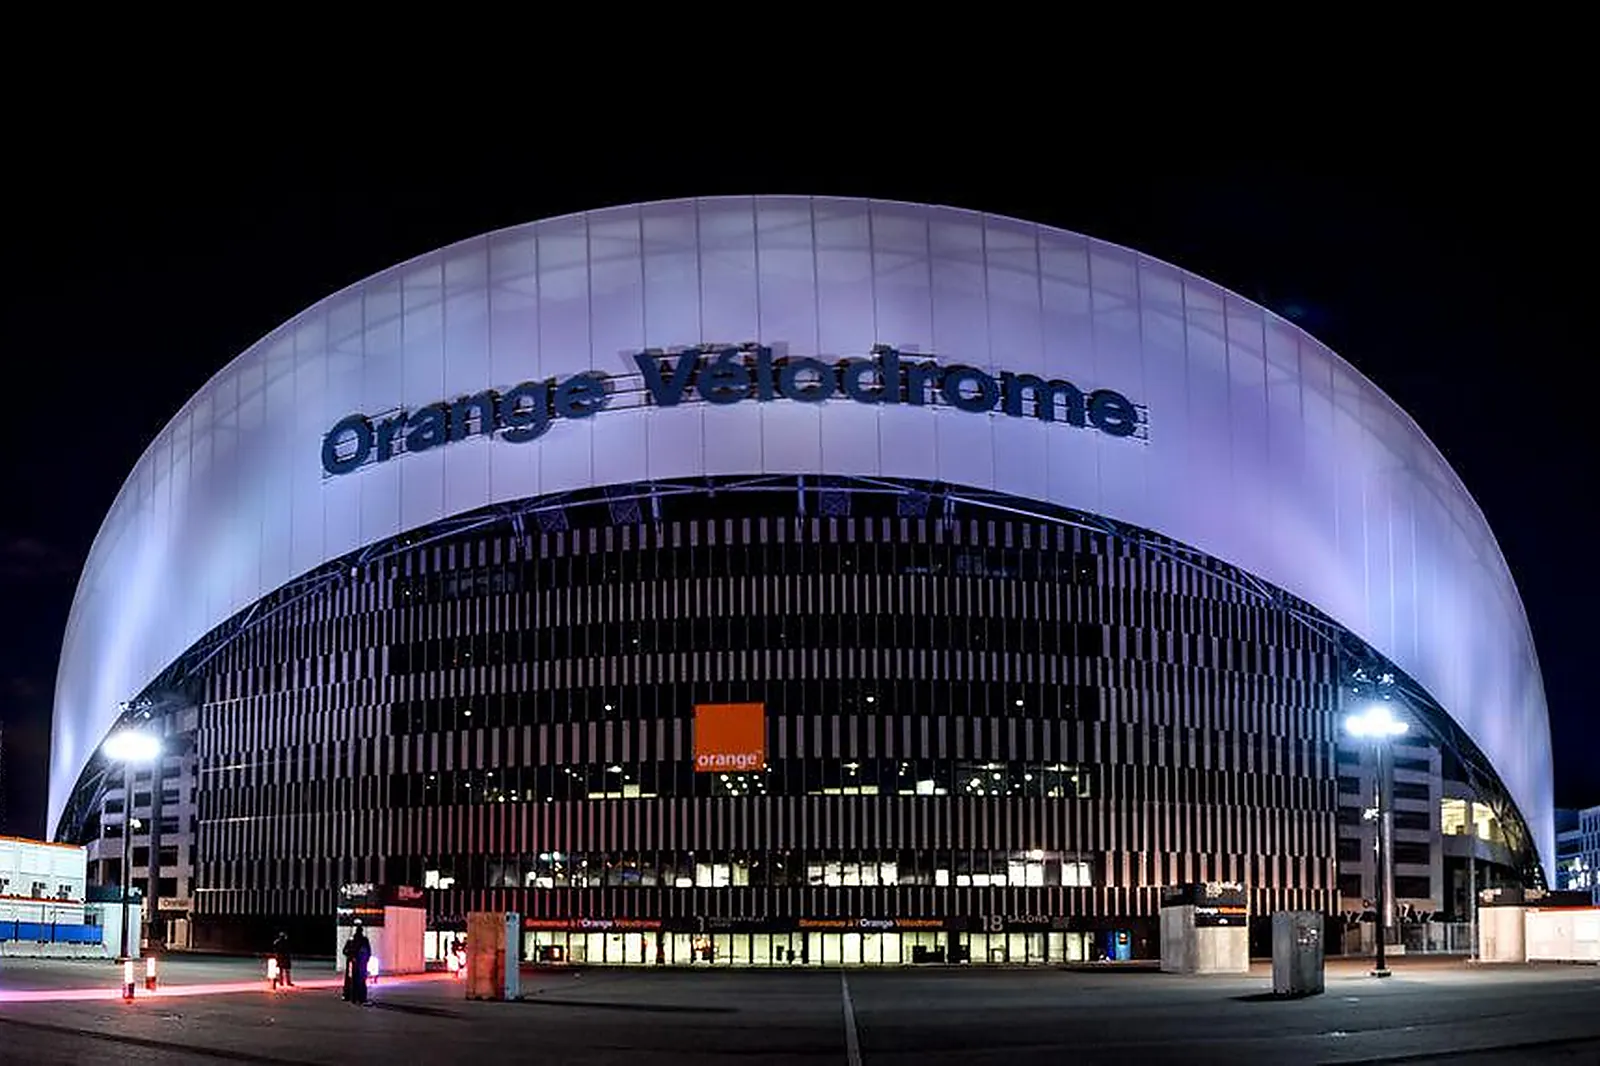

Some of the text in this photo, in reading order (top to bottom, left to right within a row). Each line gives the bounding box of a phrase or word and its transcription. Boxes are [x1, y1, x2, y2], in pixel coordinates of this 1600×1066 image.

[321, 344, 1139, 475] Orange Vélodrome
[697, 753, 758, 769] orange
[982, 914, 1003, 932] 18
